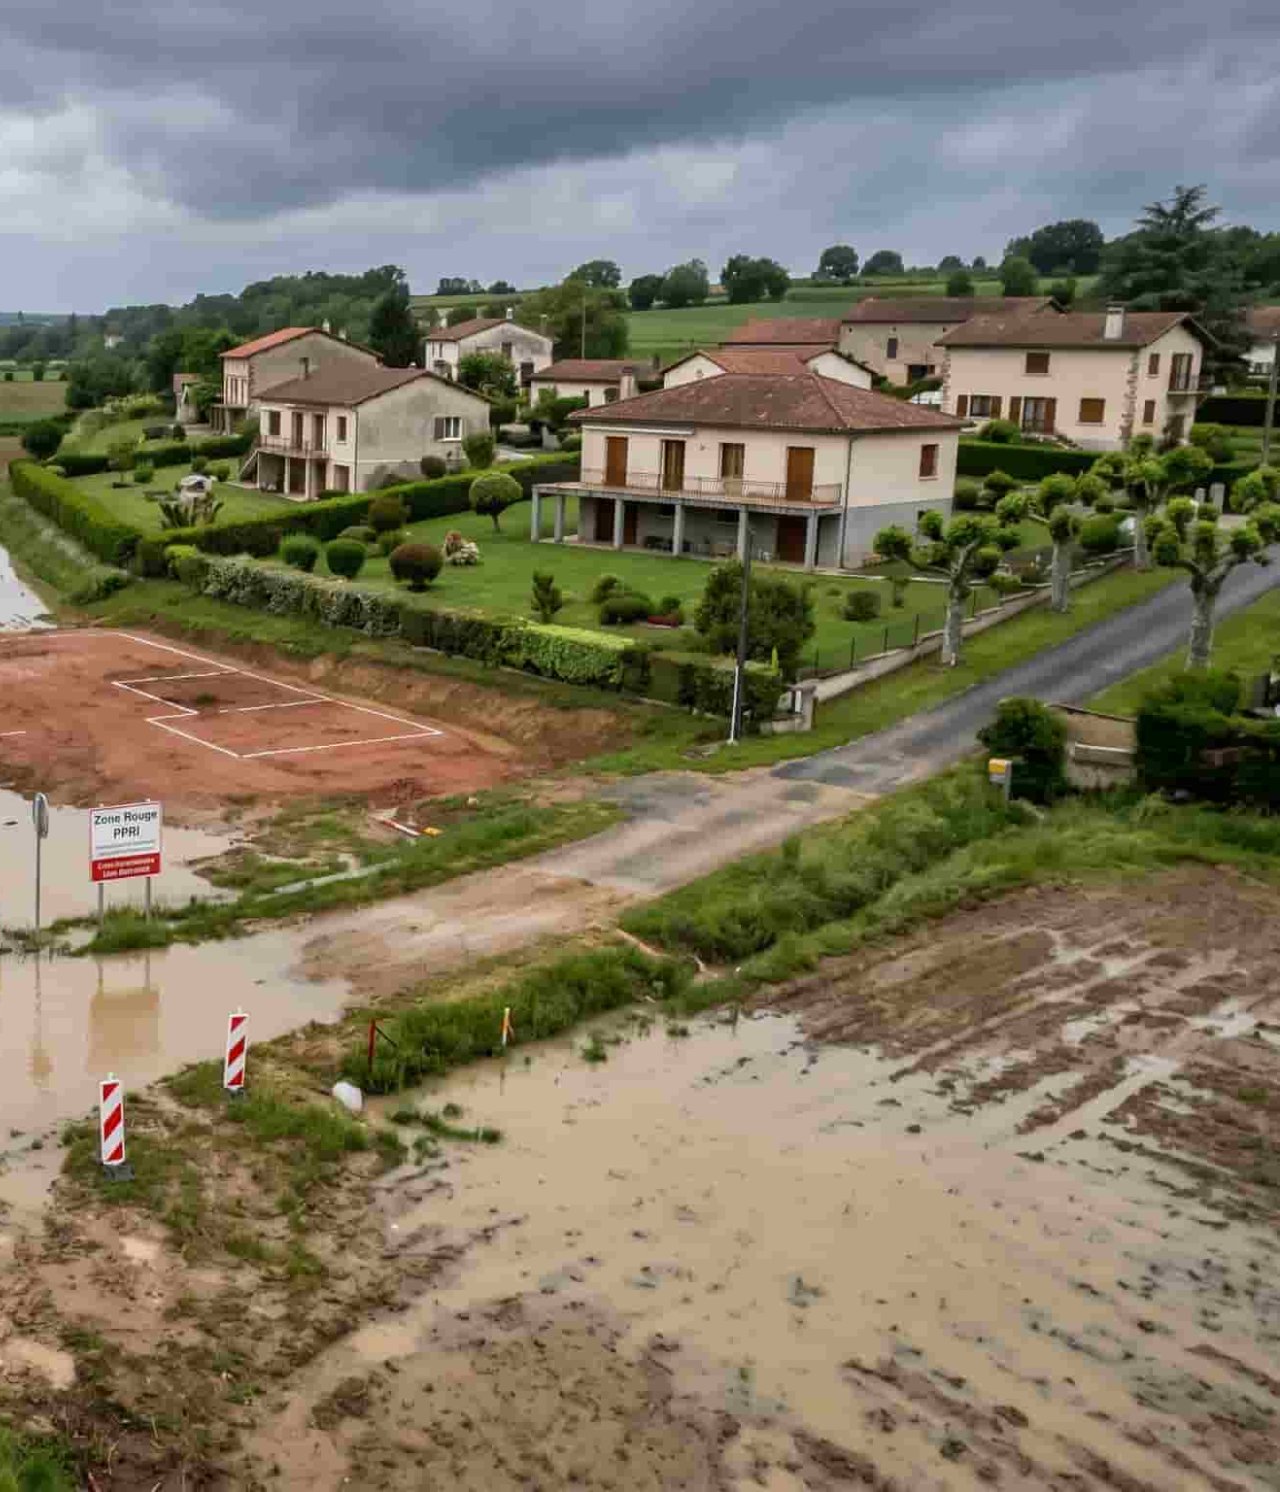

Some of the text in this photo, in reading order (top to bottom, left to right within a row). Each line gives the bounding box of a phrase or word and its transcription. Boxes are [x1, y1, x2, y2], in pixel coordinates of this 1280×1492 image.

[94, 811, 158, 825] Zone Rouge
[113, 826, 140, 839] PPRI
